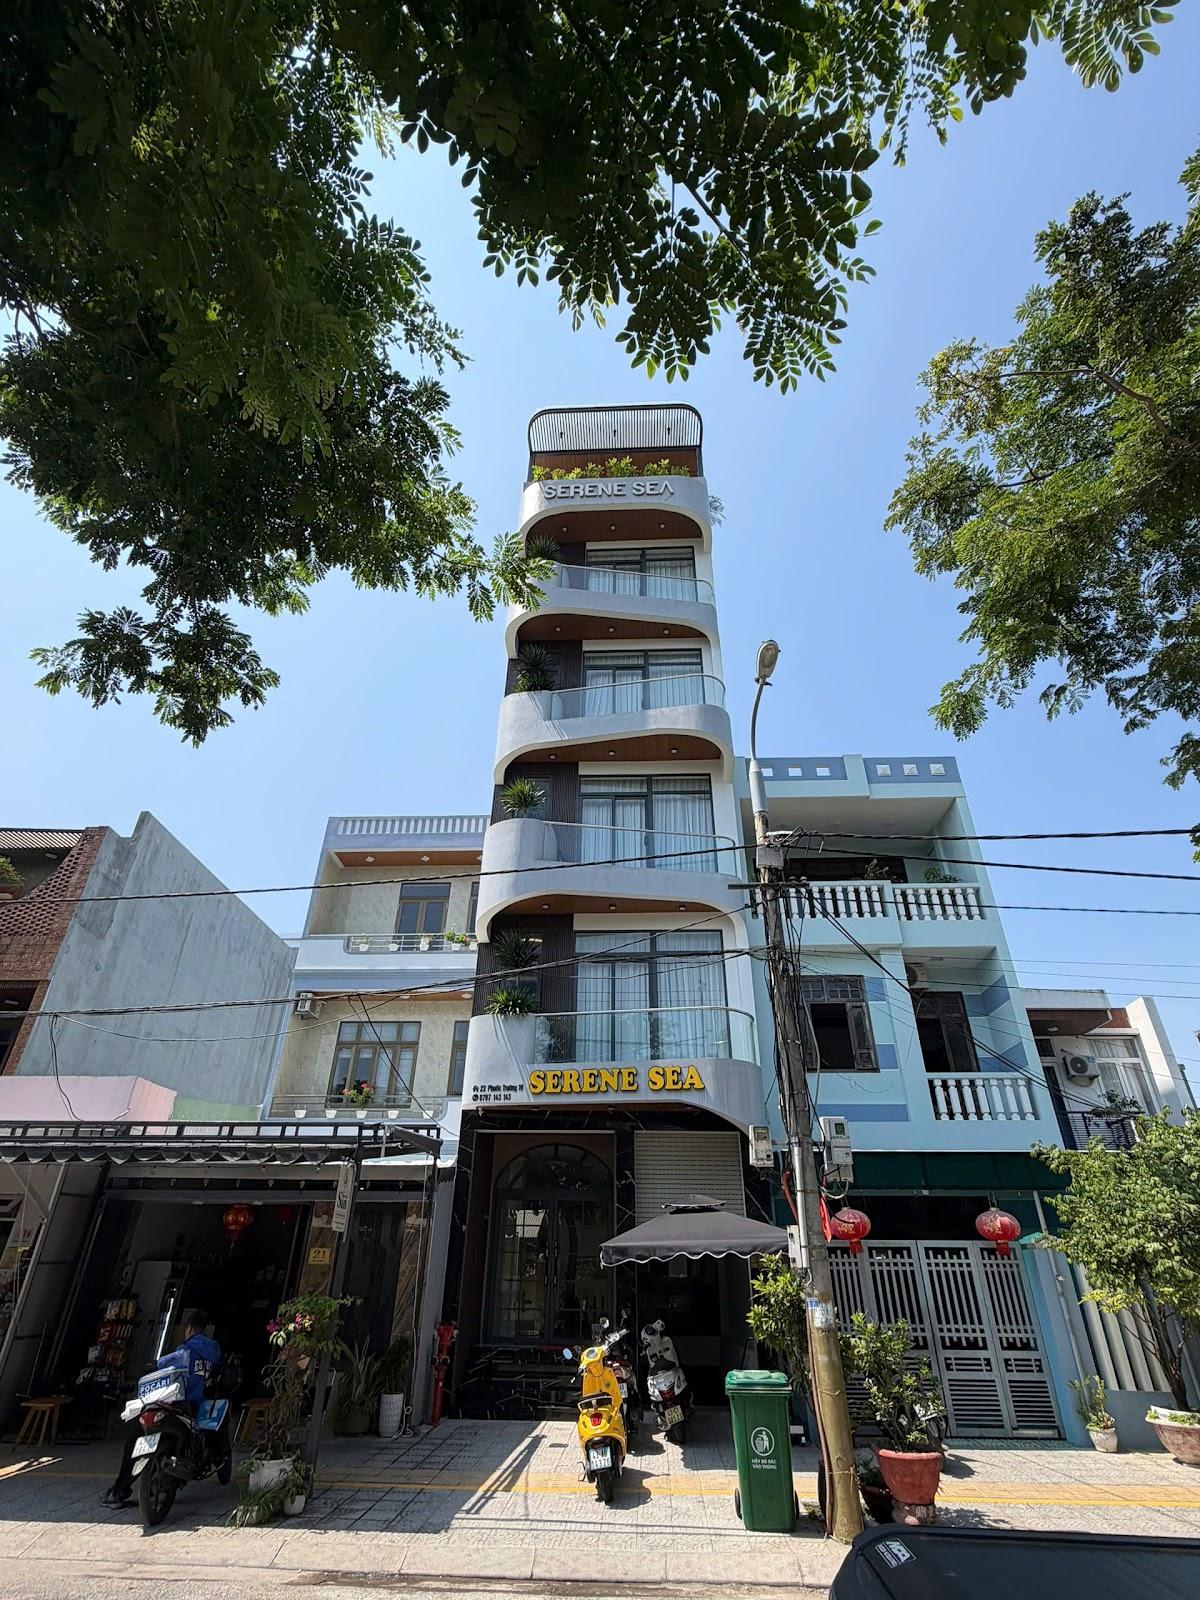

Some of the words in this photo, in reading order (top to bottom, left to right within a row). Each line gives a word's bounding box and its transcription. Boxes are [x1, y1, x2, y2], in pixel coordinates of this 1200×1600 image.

[543, 482, 626, 500] SERENE
[632, 479, 675, 497] SEA
[528, 1067, 639, 1095] SERENE
[647, 1065, 705, 1091] SEA
[139, 1377, 170, 1394] POCARI
